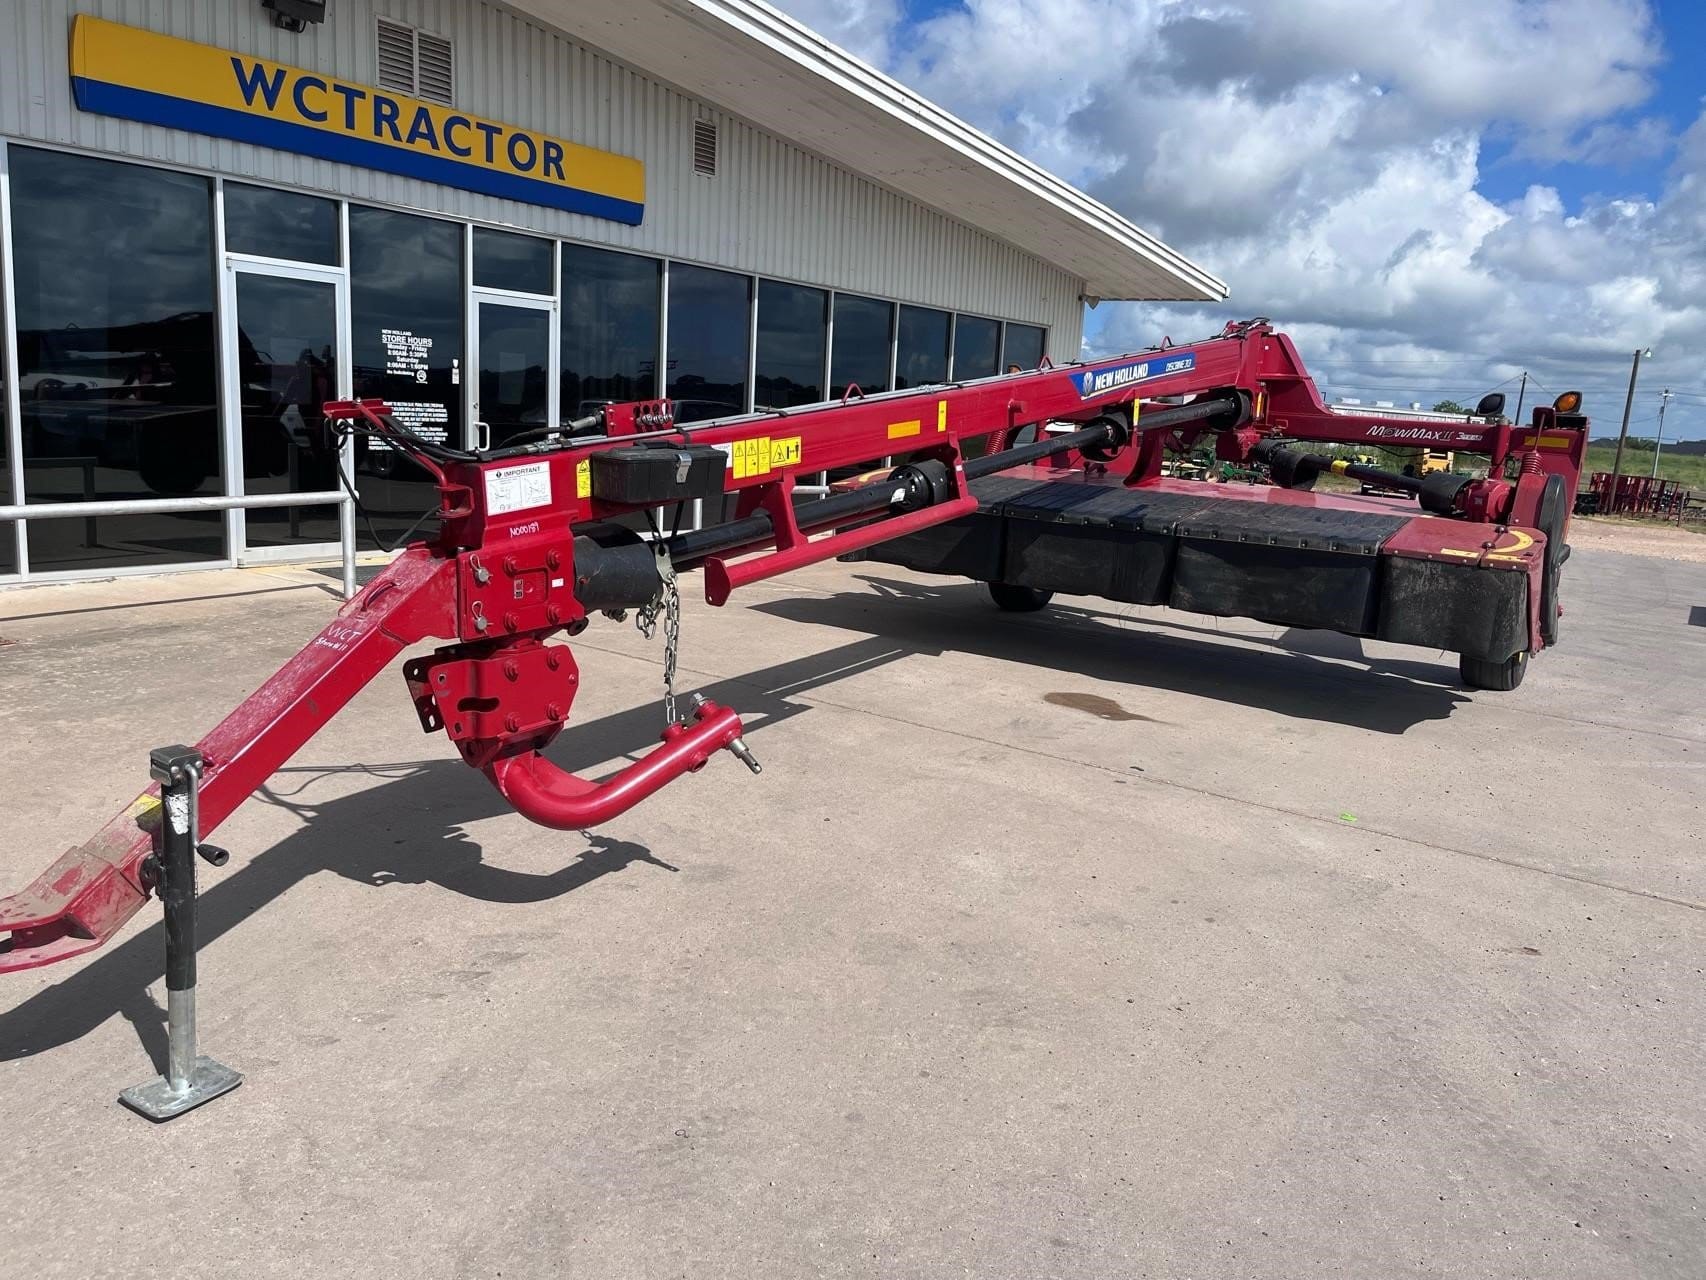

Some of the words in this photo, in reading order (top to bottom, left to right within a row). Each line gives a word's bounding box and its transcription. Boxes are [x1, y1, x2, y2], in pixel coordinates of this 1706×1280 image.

[230, 56, 566, 181] WCTRACTOR
[382, 335, 407, 344] STORE
[407, 337, 433, 346] HOURS
[397, 356, 419, 364] Saturday
[1095, 370, 1114, 391] NEW
[1114, 363, 1149, 385] HOLLAND
[504, 466, 540, 477] IMPORTANT
[328, 625, 362, 642] WCT
